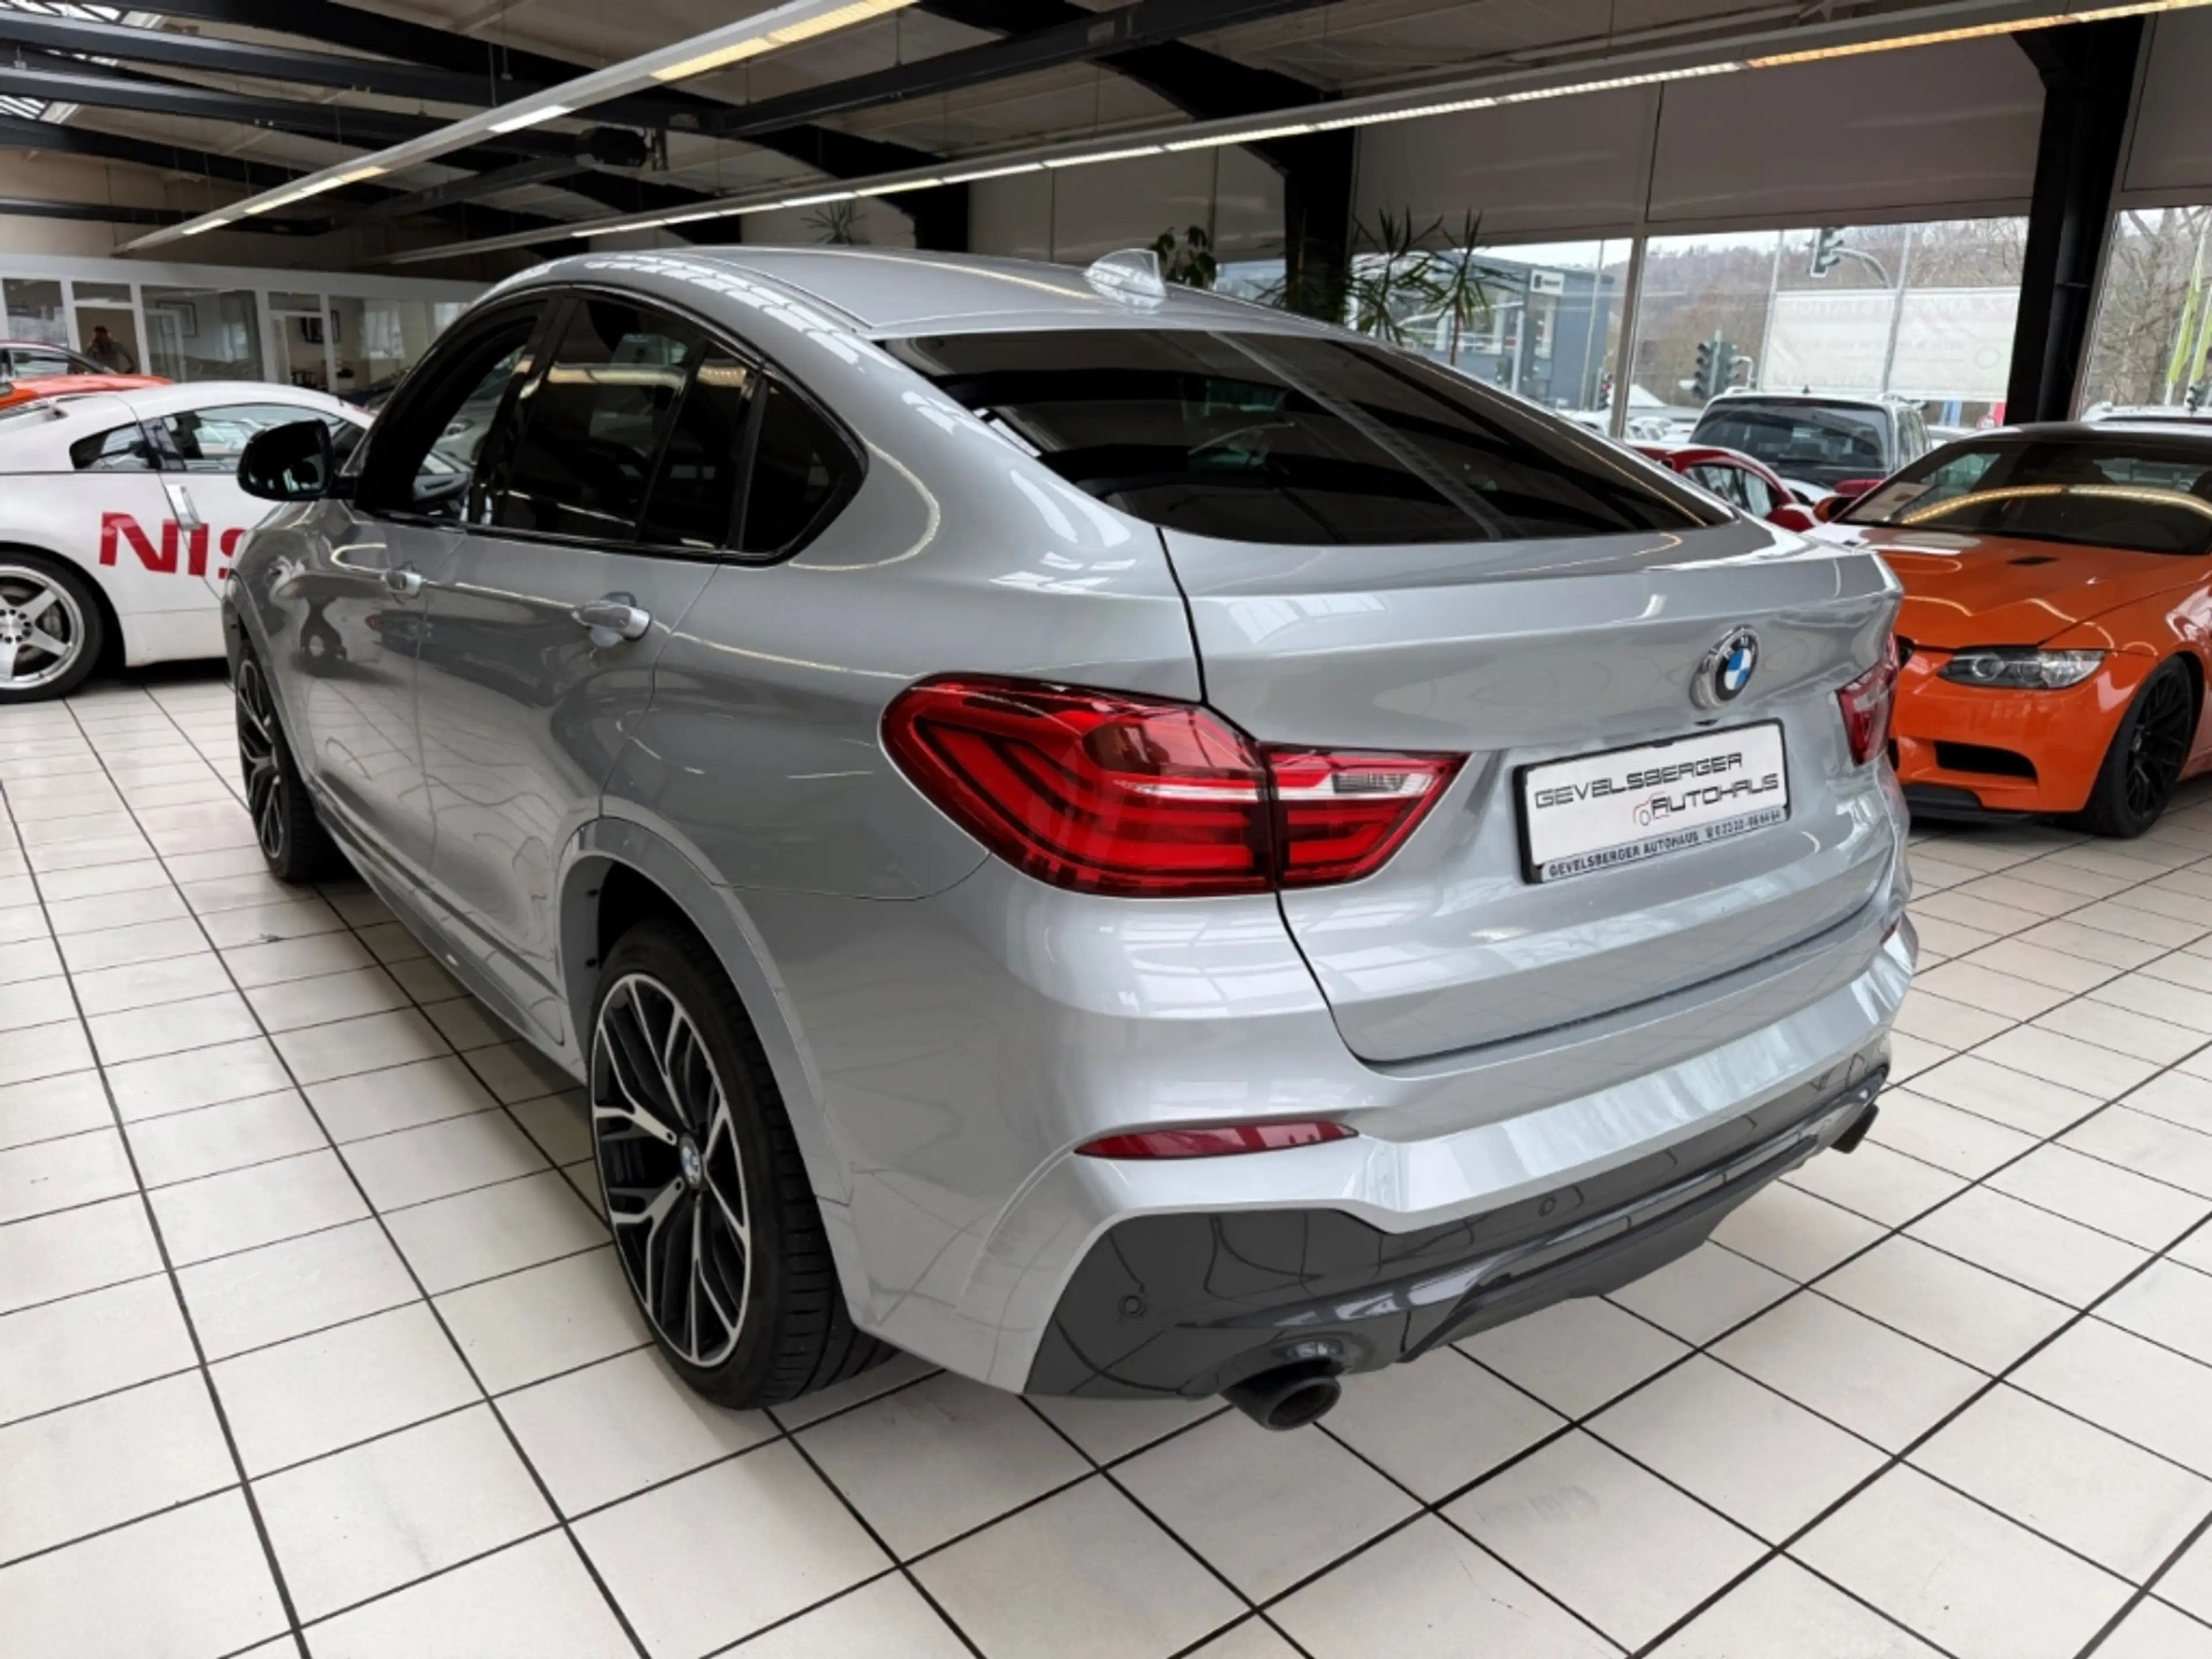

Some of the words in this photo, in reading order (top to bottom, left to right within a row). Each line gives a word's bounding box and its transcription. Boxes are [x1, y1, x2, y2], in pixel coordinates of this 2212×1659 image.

[1535, 752, 1742, 808] GEVELSBERGER
[1652, 773, 1778, 815] AUTOHAUS
[1549, 844, 1641, 877] GEVELSBERGER
[1643, 831, 1699, 854] AUTOHAUS
